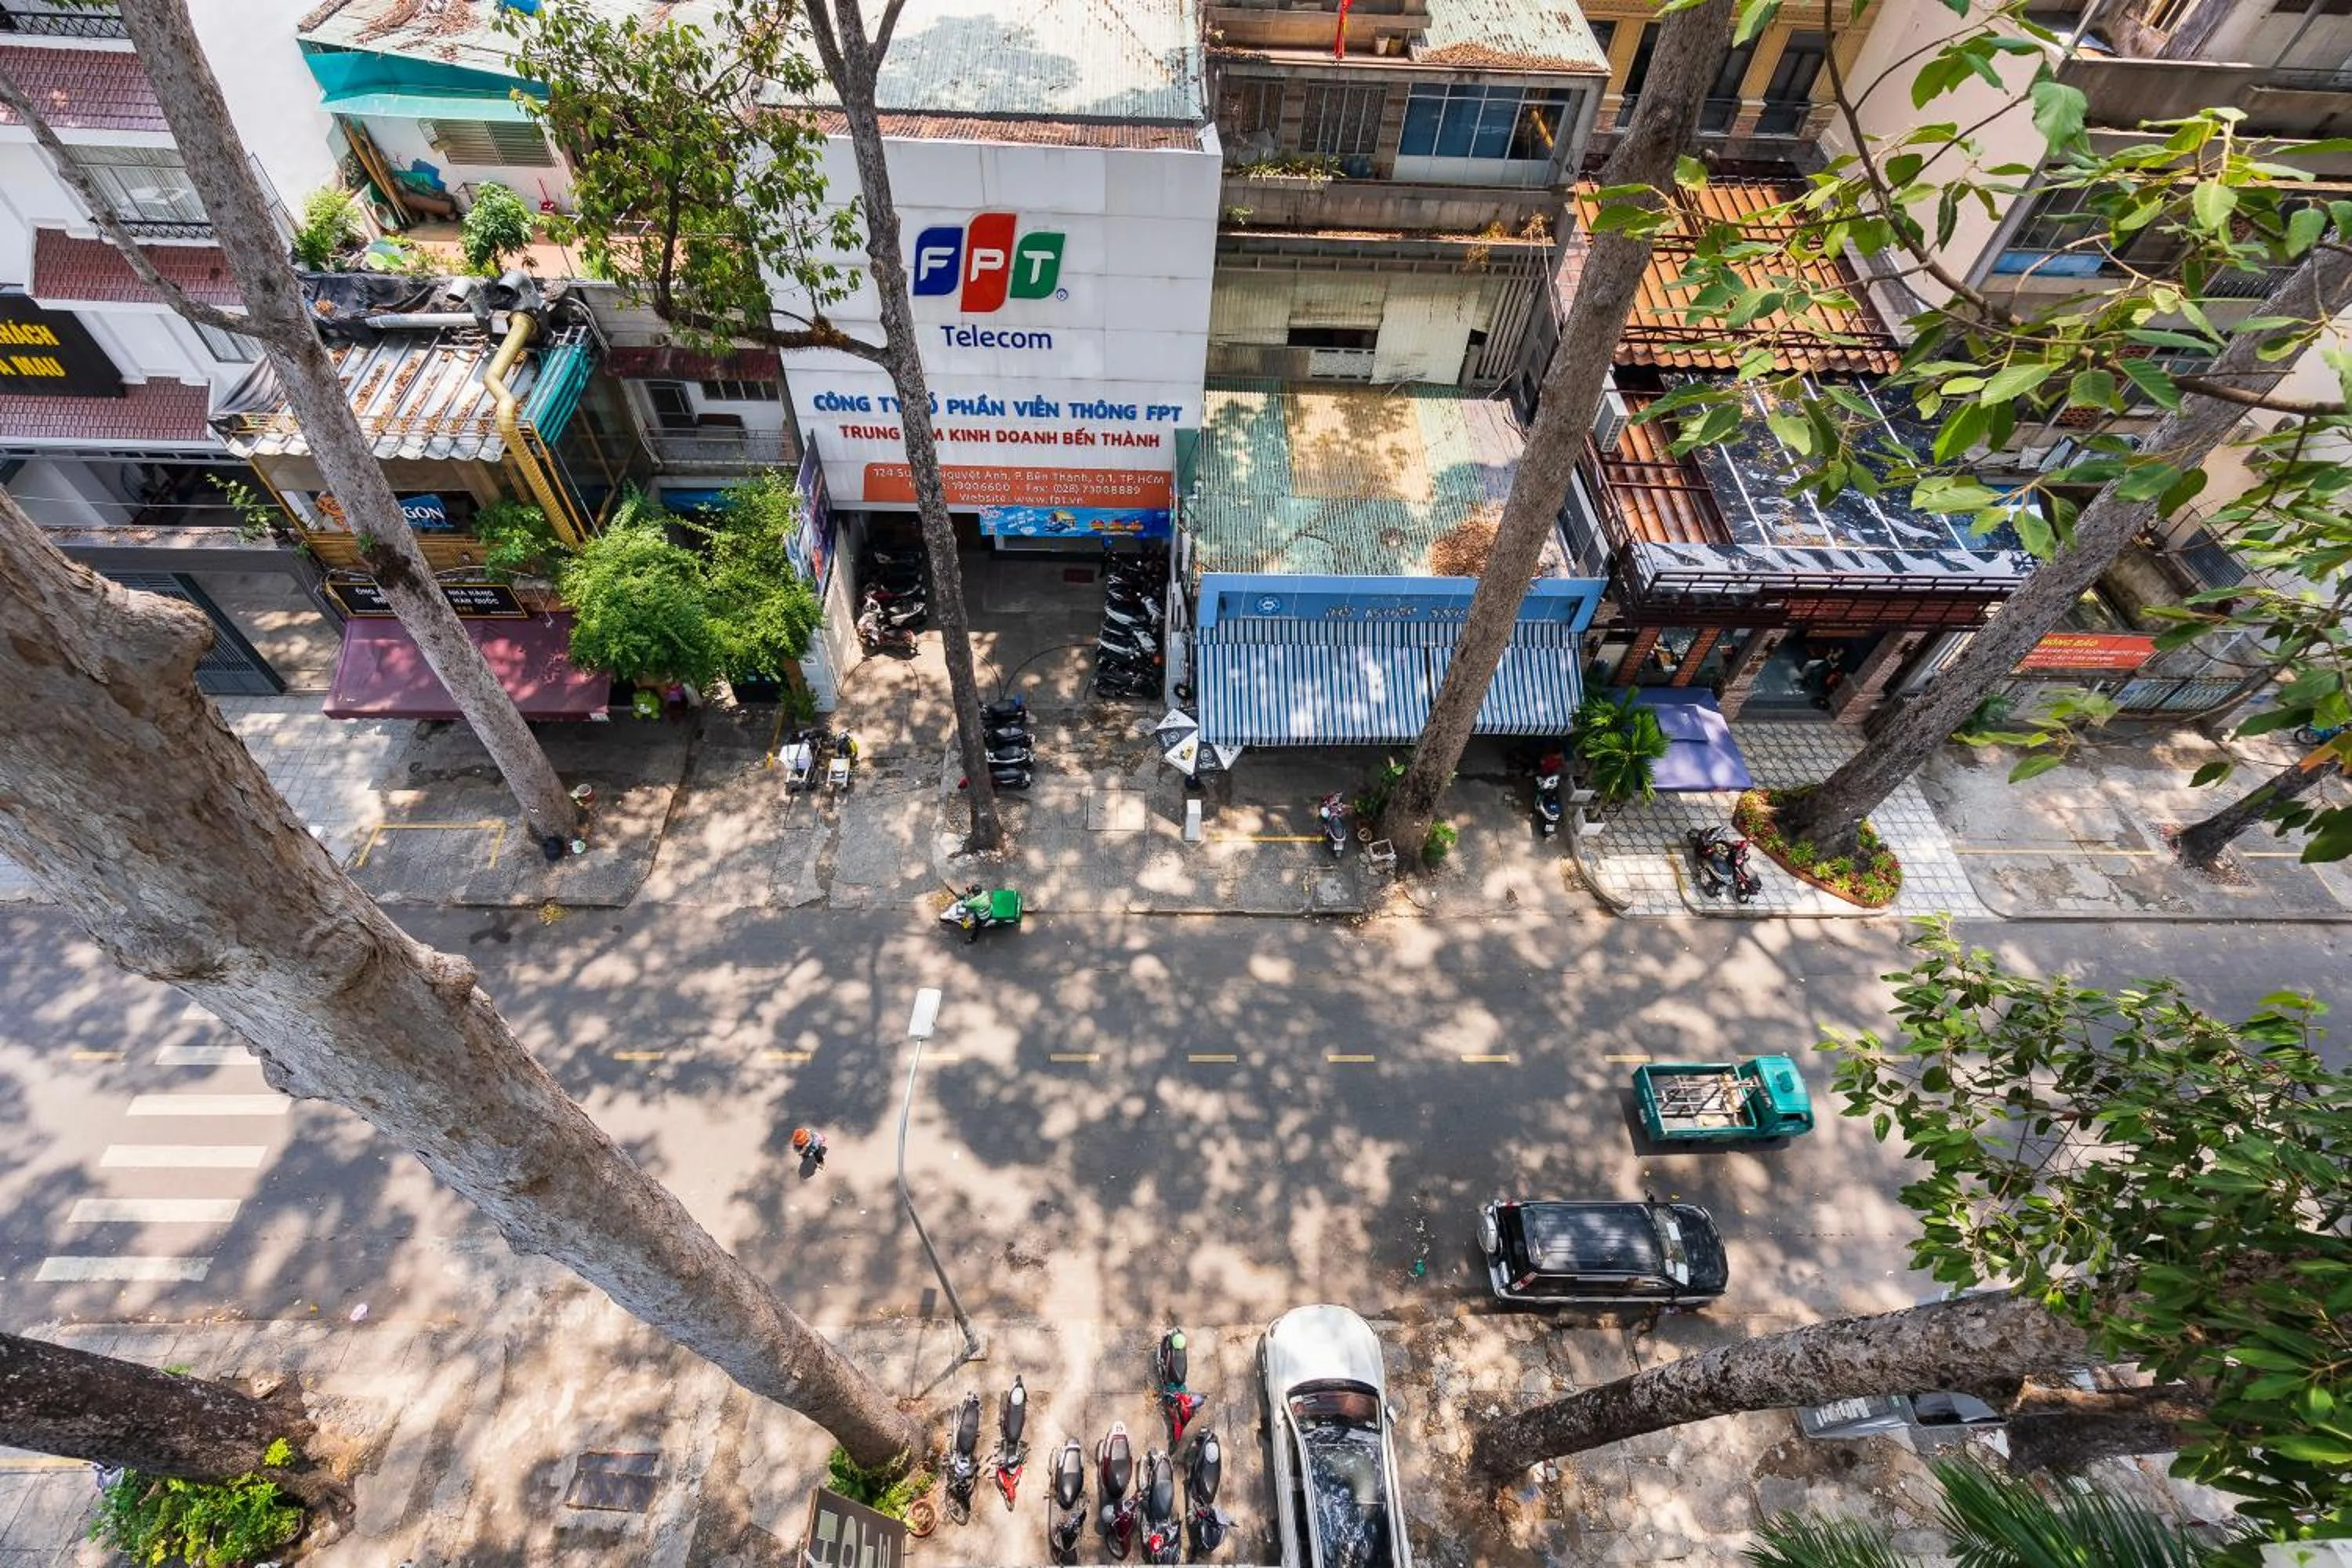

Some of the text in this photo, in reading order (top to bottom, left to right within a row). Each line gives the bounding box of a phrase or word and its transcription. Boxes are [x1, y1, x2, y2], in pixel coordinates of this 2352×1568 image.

[0, 319, 60, 345] HÁCH
[940, 325, 1052, 350] Telecom
[9, 355, 66, 376] MAU
[814, 390, 871, 412] CÔNG
[878, 396, 902, 413] TY
[947, 394, 1005, 416] PHẦN
[1069, 399, 1137, 420] THÔNG
[1145, 405, 1182, 422] FPT
[839, 425, 900, 441] TRUNG
[949, 430, 990, 443] KINH
[996, 430, 1057, 445] DOANH
[1062, 428, 1095, 446] BẾN
[1101, 430, 1160, 448] THÀNH
[1121, 474, 1164, 485] TP.HCM
